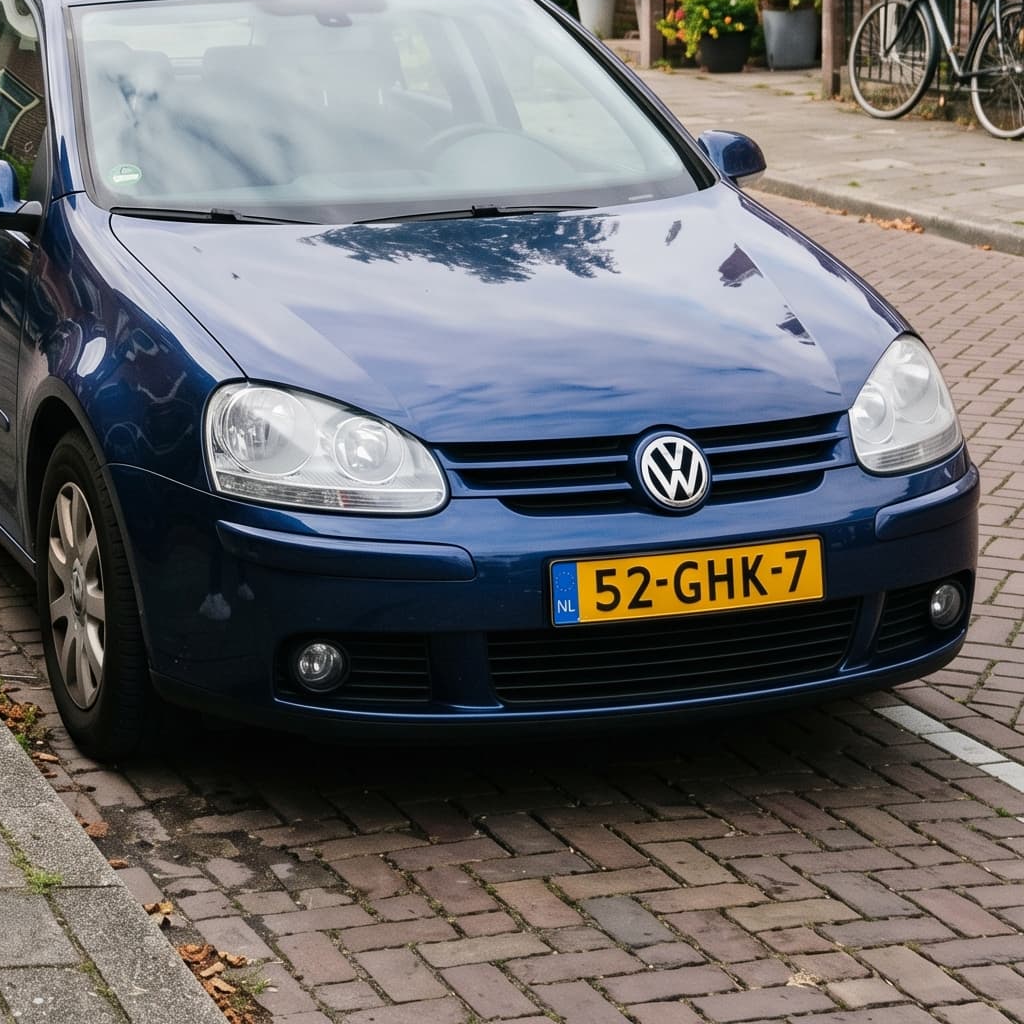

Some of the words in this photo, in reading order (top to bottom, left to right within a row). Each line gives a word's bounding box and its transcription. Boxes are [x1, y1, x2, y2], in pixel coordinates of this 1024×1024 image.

[642, 437, 707, 507] VW
[557, 599, 576, 613] NL
[595, 549, 808, 612] 52-GHK-7
